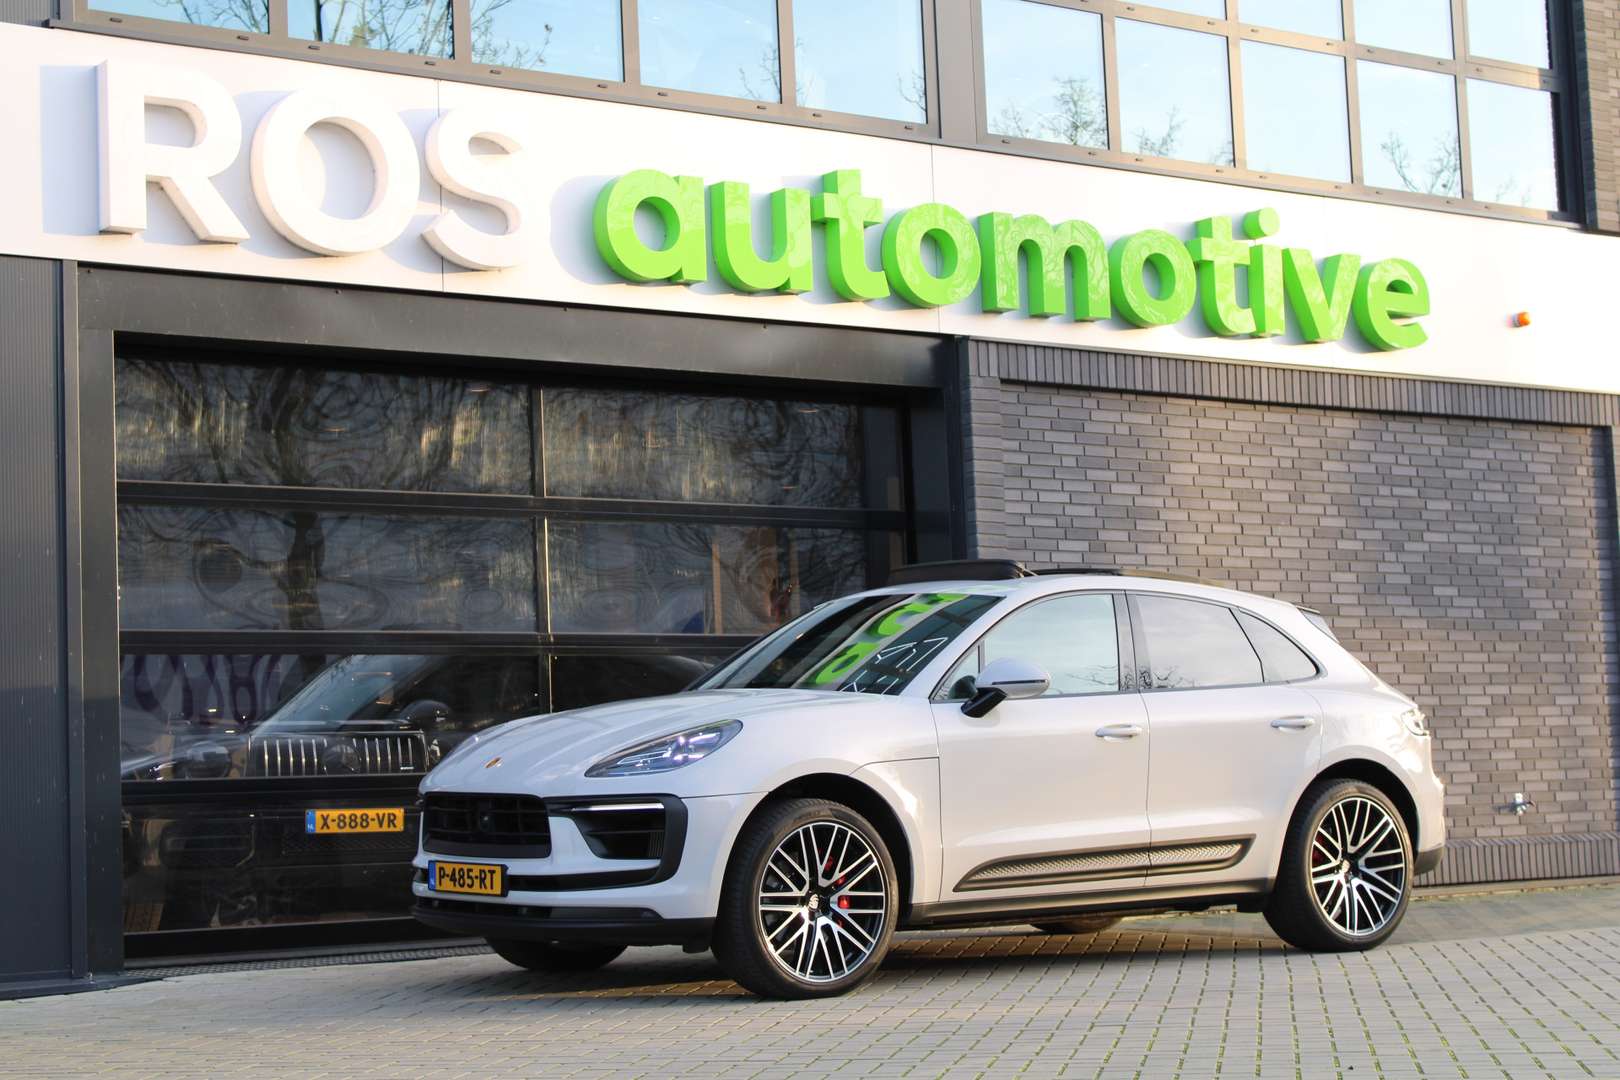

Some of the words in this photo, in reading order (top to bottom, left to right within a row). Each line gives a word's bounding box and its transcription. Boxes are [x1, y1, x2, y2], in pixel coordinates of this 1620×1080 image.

[97, 57, 546, 272] ROS
[593, 168, 1430, 352] automotive
[320, 812, 397, 830] X-888-VR
[438, 866, 497, 890] P-485-RT
